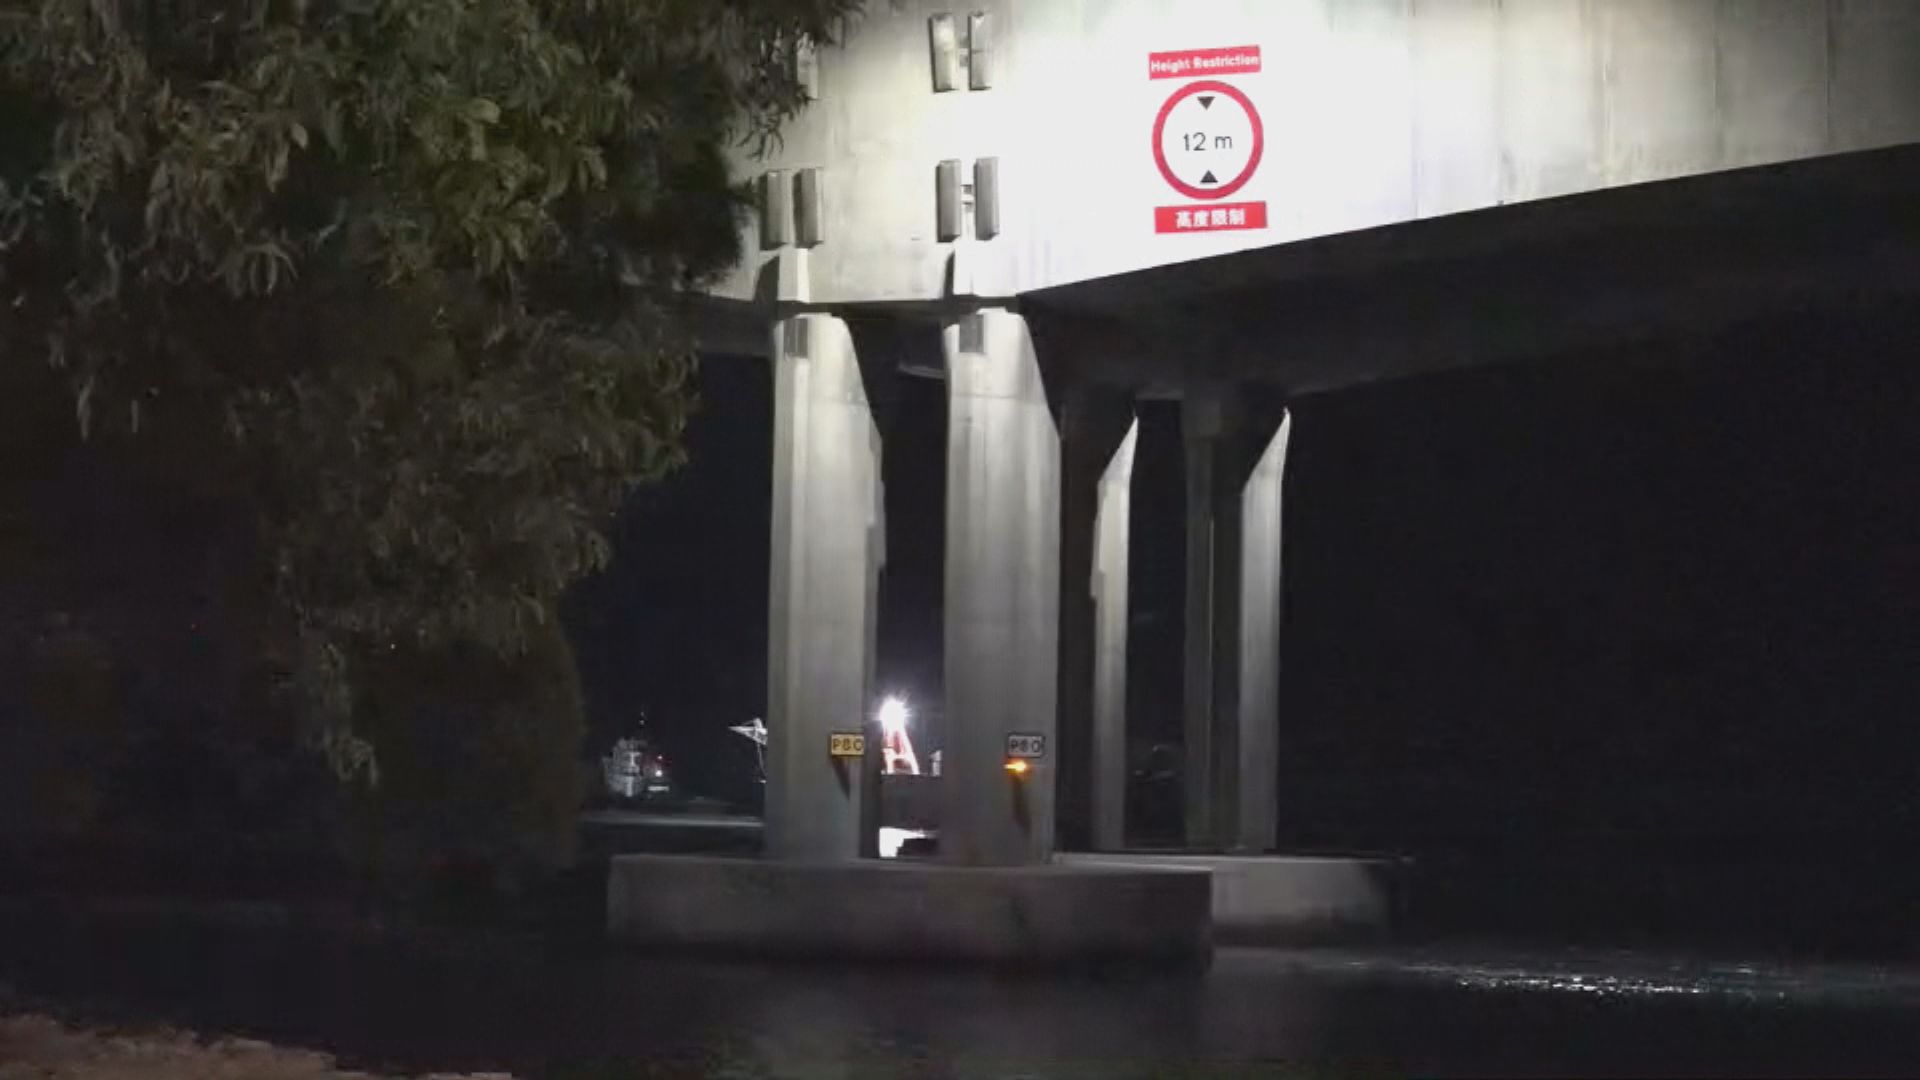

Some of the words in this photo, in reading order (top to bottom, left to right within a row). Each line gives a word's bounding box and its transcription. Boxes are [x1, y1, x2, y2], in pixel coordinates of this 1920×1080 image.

[1151, 59, 1191, 74] Height
[1193, 54, 1260, 70] Restriction
[1183, 132, 1206, 151] 12
[1215, 135, 1233, 149] m
[1176, 208, 1246, 229] 高度限制
